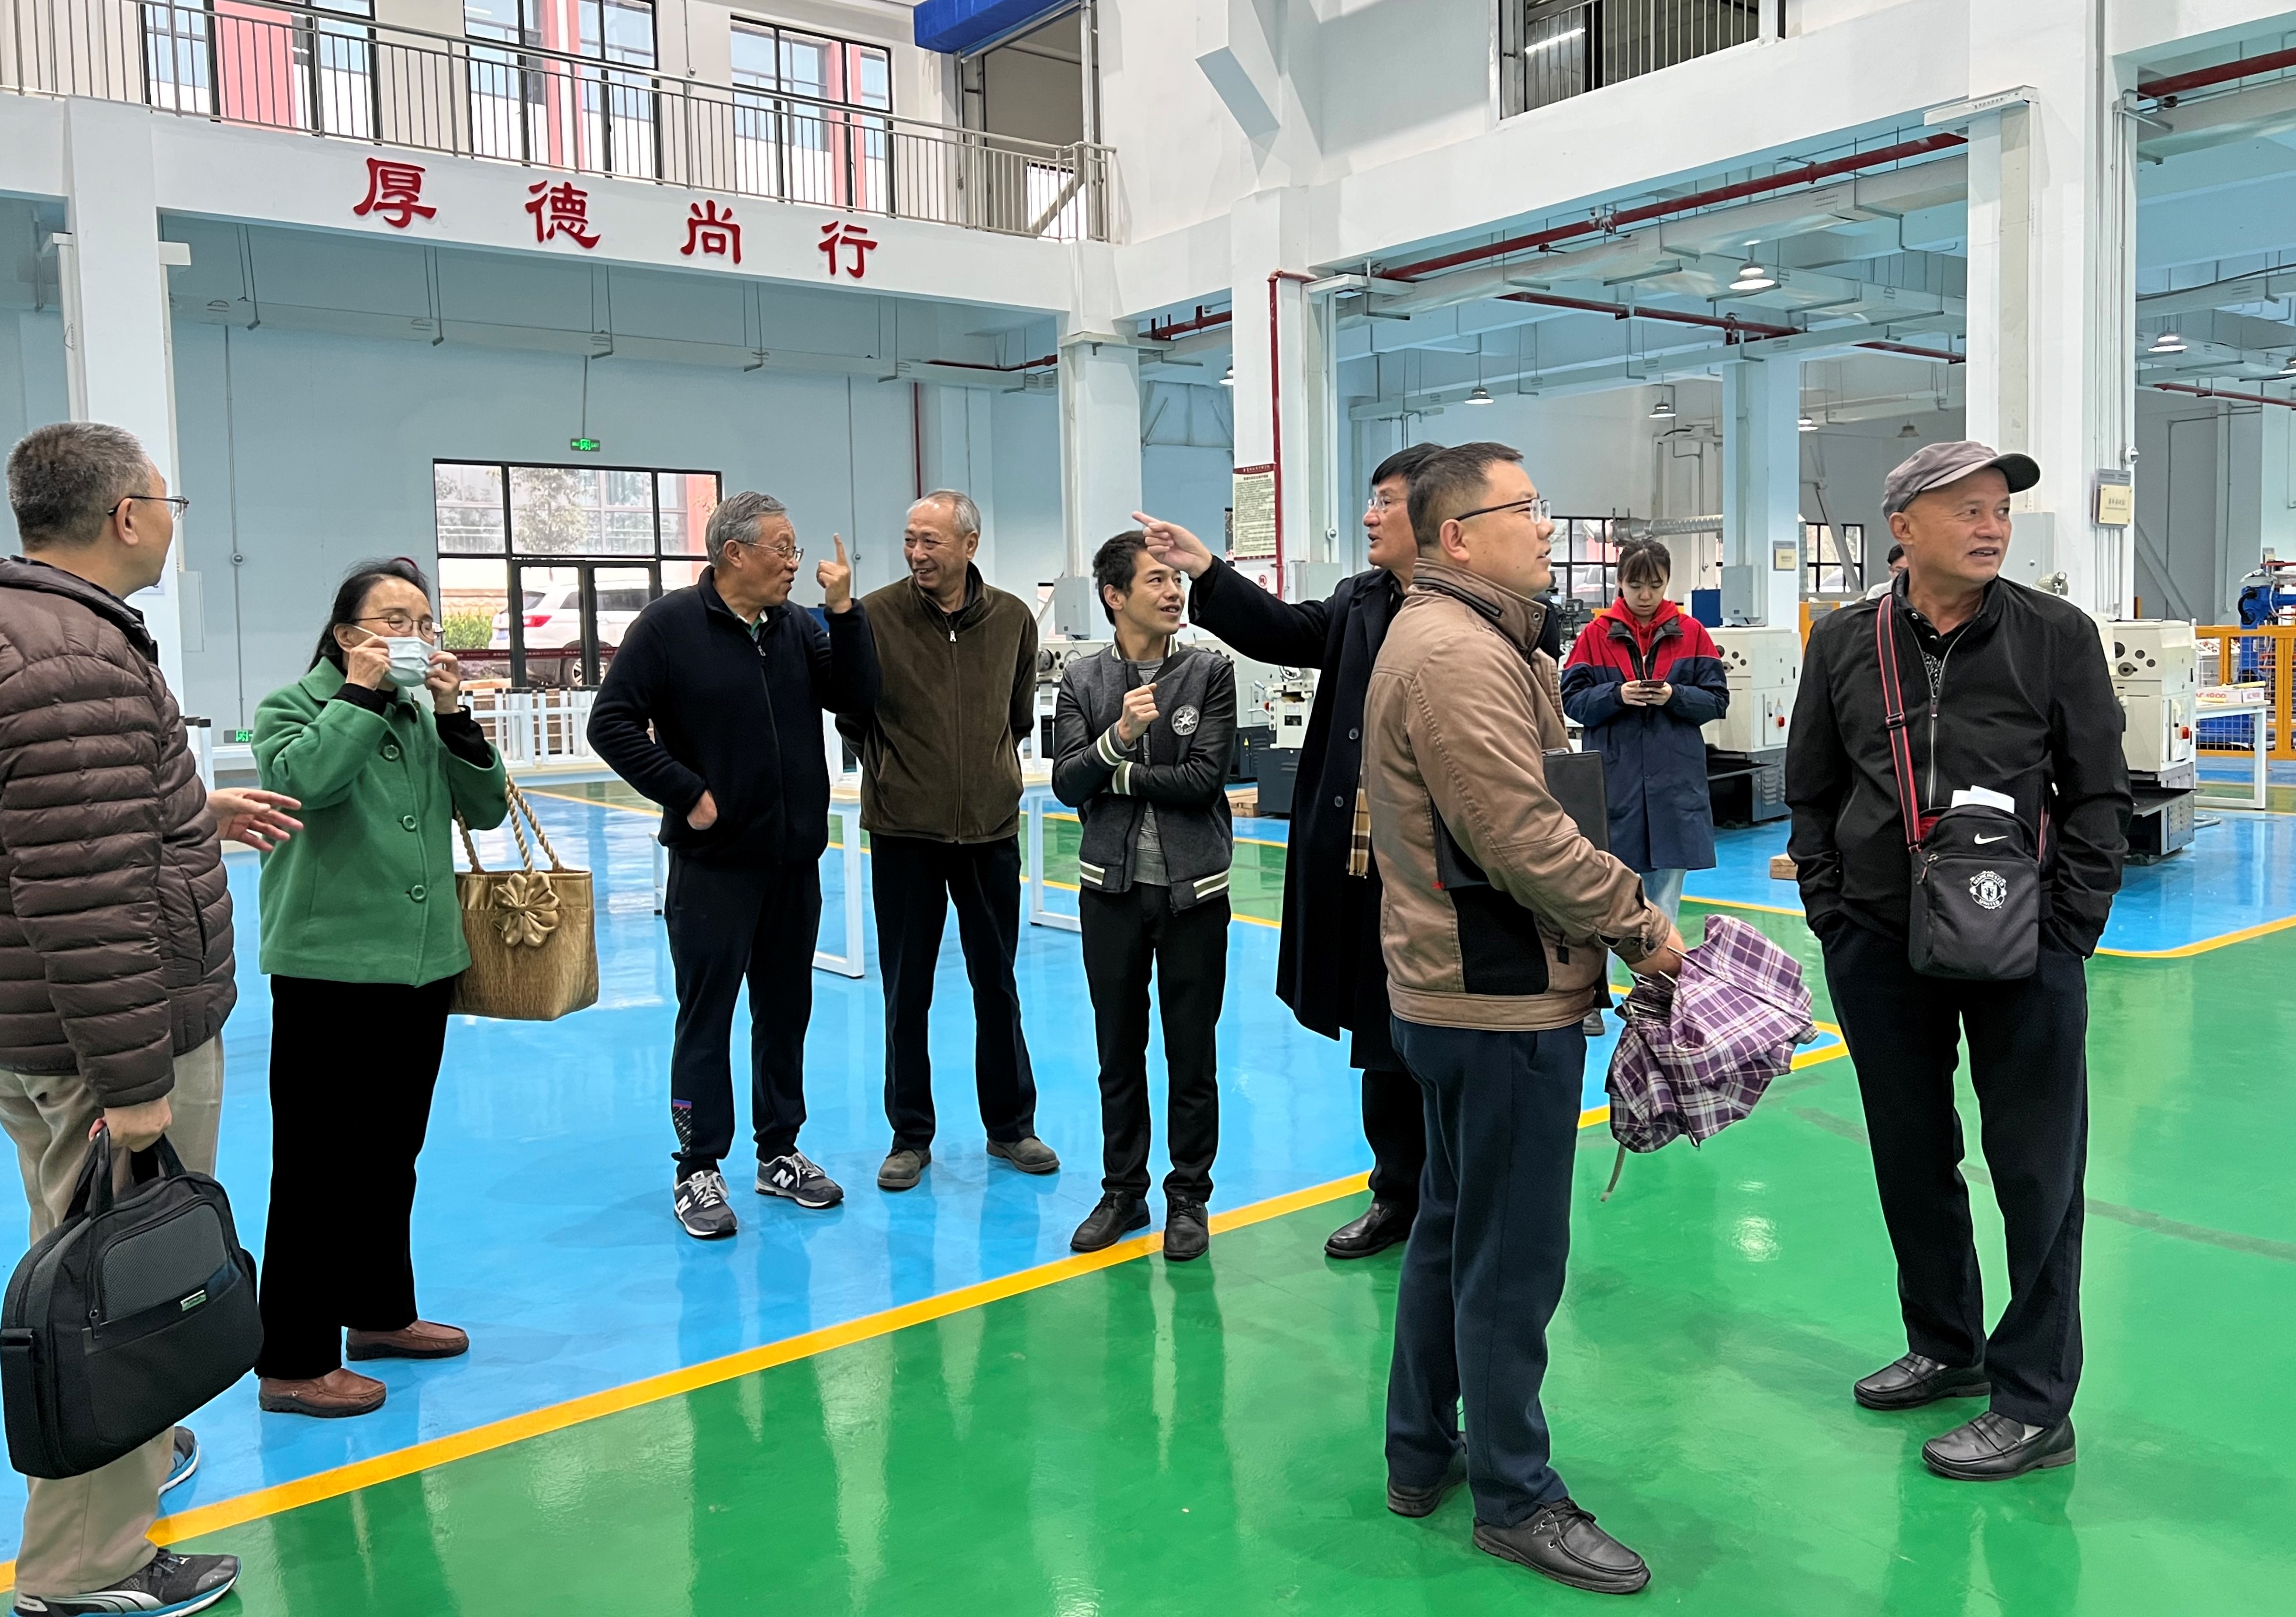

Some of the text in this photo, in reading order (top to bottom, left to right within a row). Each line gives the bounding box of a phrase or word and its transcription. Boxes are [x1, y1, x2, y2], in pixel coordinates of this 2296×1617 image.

[353, 157, 877, 279] 厚德尚行
[772, 1169, 794, 1188] N
[677, 1194, 692, 1215] N
